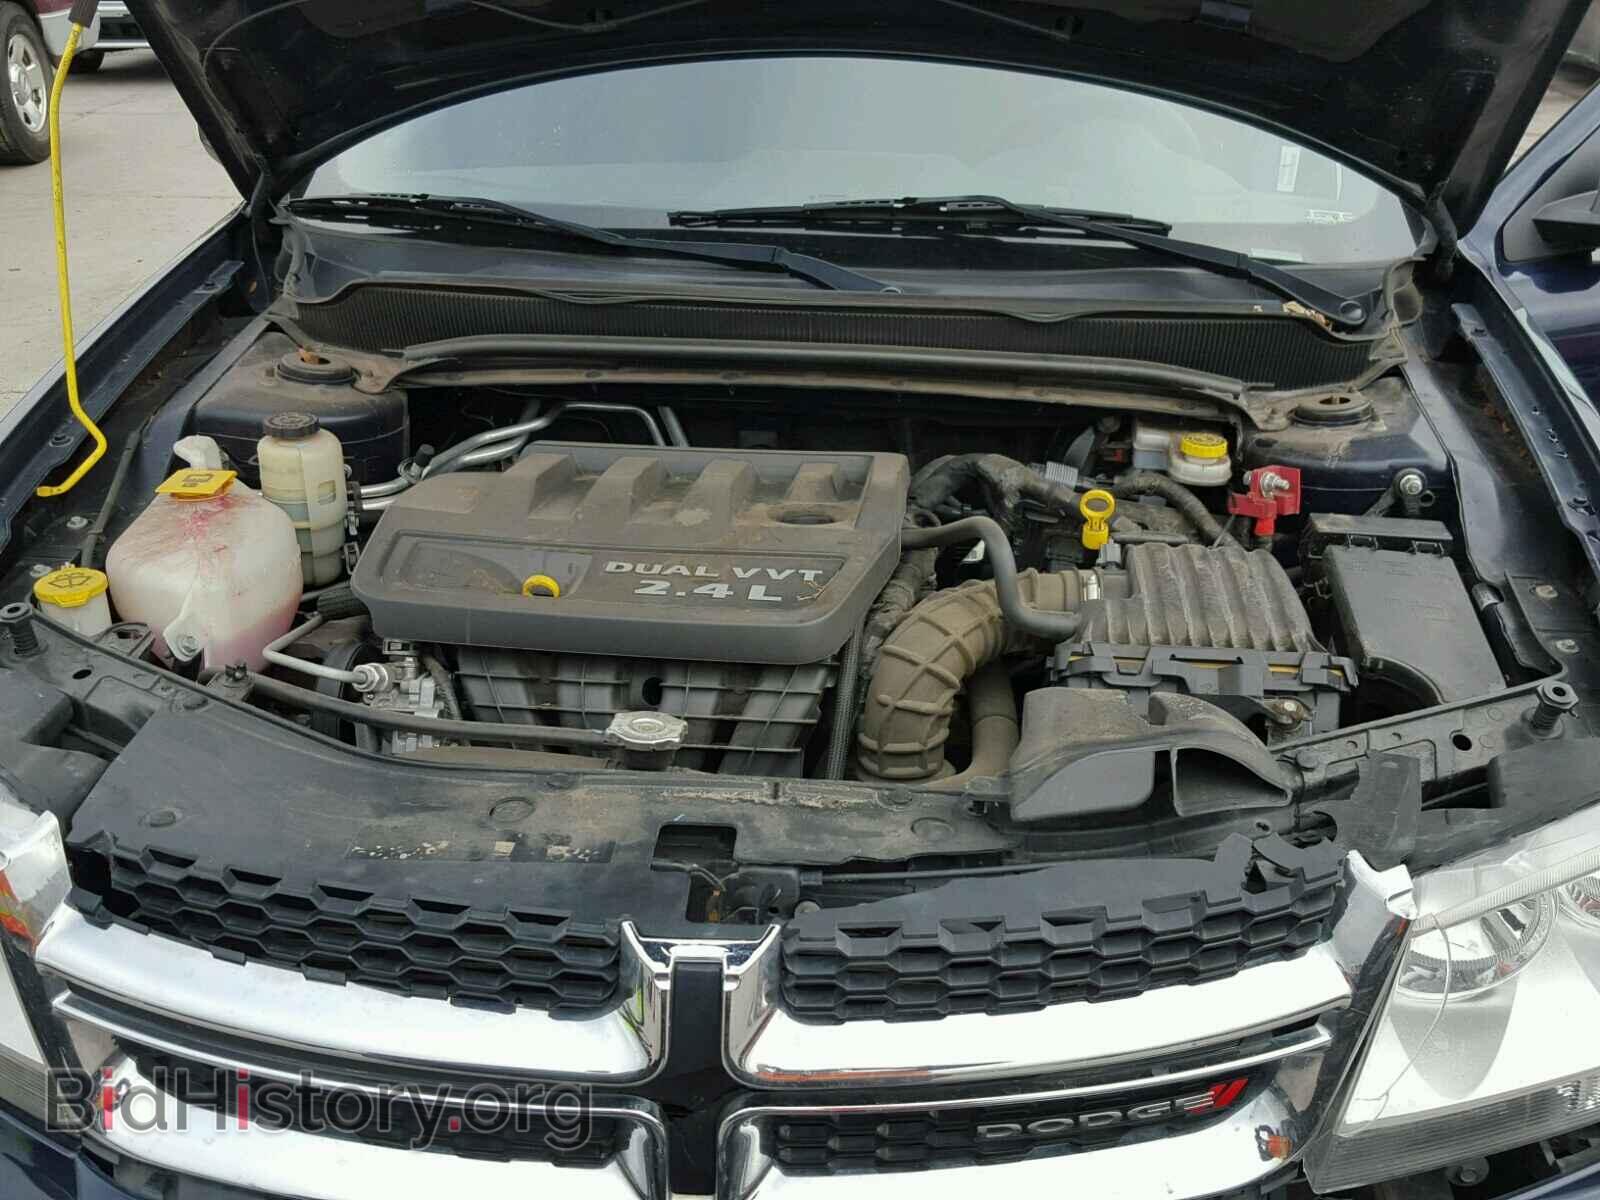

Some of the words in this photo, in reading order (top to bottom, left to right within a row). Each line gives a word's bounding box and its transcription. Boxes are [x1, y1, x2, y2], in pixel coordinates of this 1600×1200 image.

[605, 561, 719, 577] DUAL
[732, 567, 823, 581] VVT
[976, 1091, 1215, 1138] DODGE
